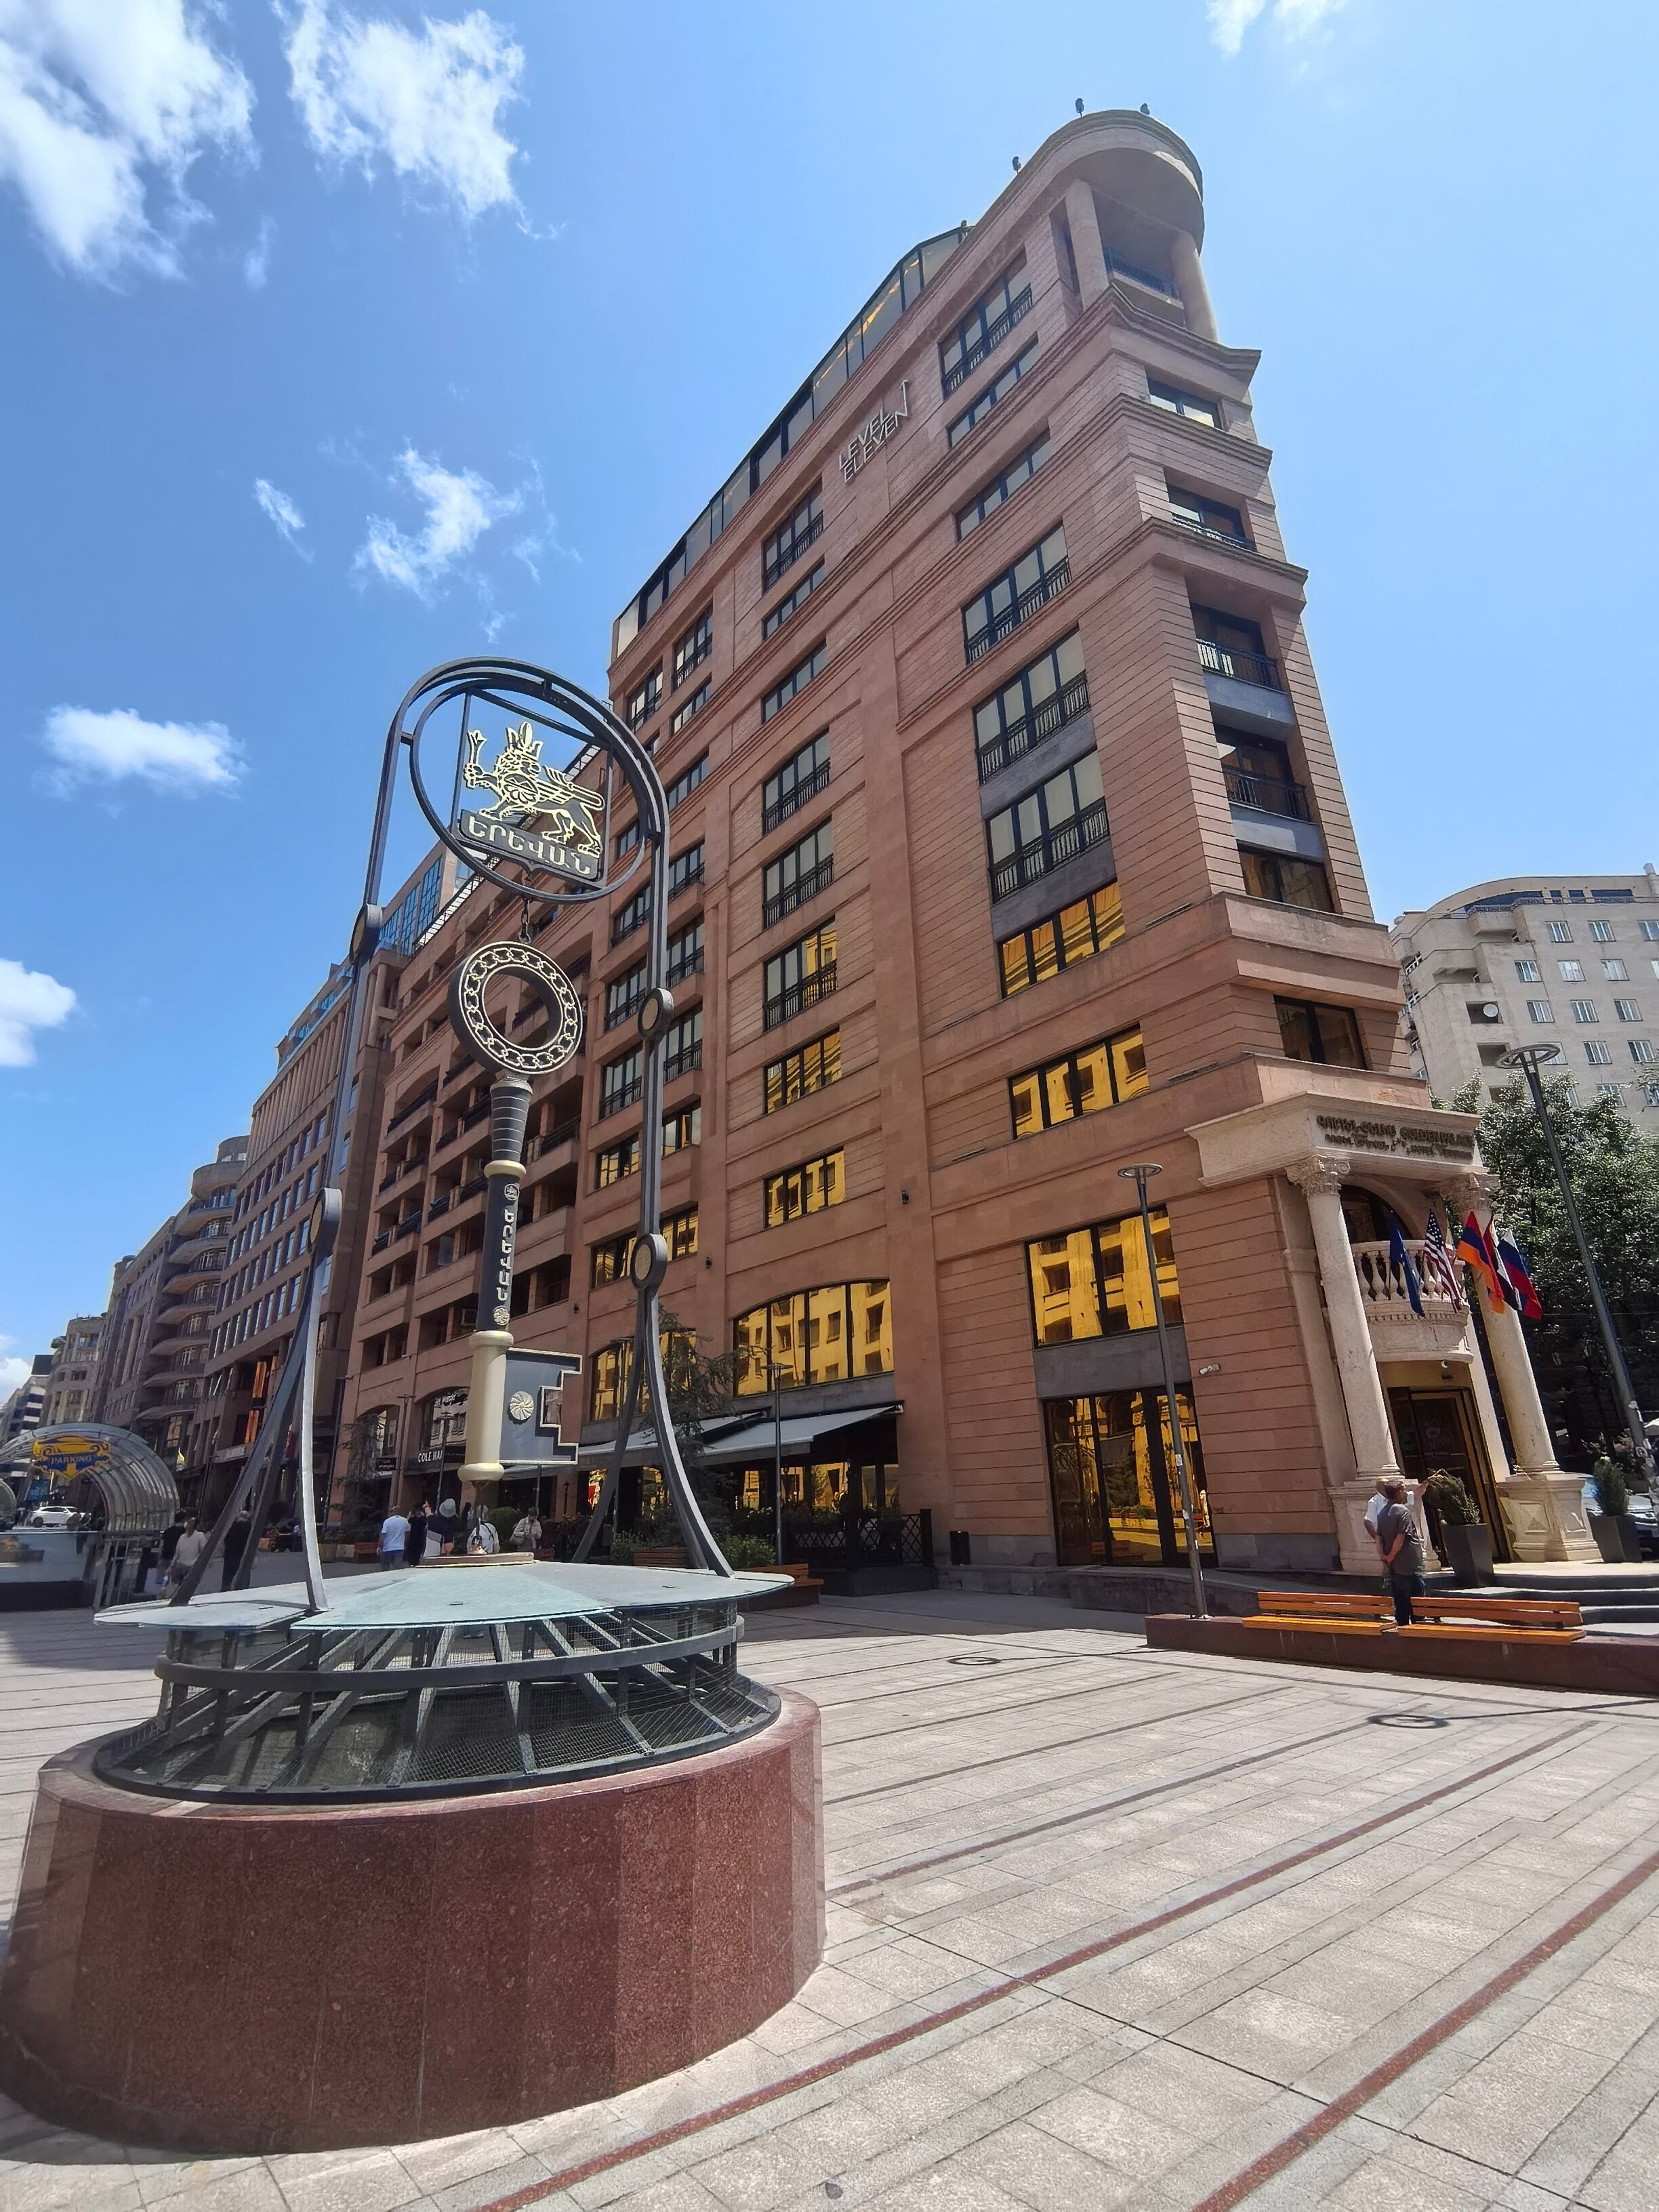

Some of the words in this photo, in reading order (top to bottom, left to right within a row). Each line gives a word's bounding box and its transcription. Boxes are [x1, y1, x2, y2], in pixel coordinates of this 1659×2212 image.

[838, 407, 891, 470] LEVEL
[844, 380, 908, 483] ELEVEN
[468, 815, 590, 874] ԵՐԵՎԱՆ
[496, 1208, 515, 1302] ԵՐԵՎԱՆ
[50, 1454, 92, 1465] PARKING
[417, 1451, 432, 1462] COLE
